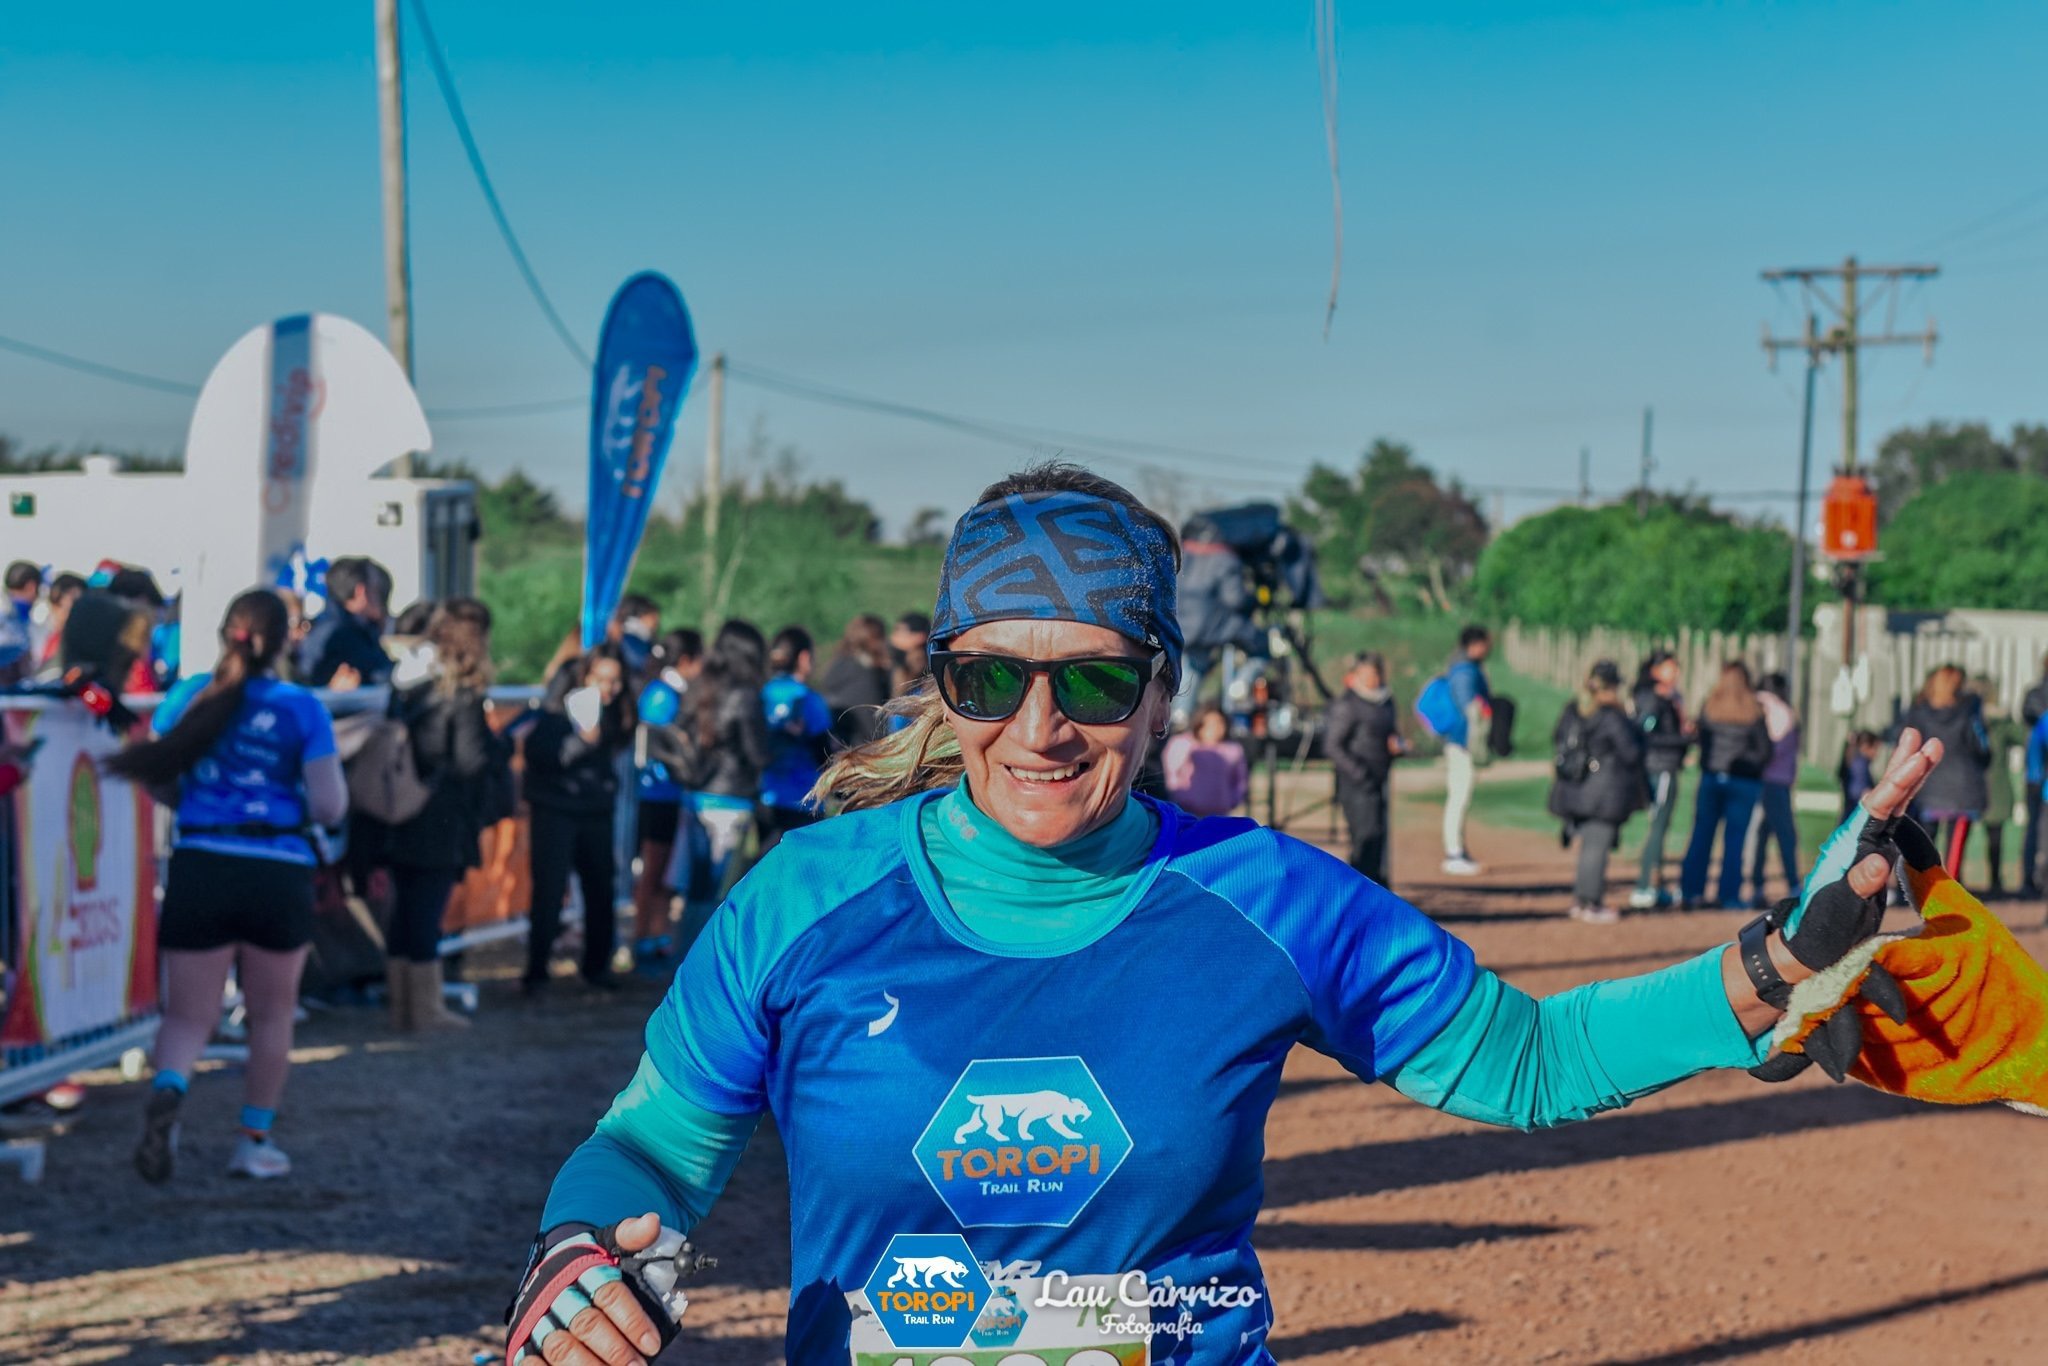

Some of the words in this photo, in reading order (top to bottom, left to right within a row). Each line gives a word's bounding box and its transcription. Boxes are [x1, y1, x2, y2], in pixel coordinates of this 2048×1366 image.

[936, 1144, 1101, 1181] TOROPI
[979, 1180, 1021, 1196] TRAIL
[1027, 1178, 1064, 1193] RUN
